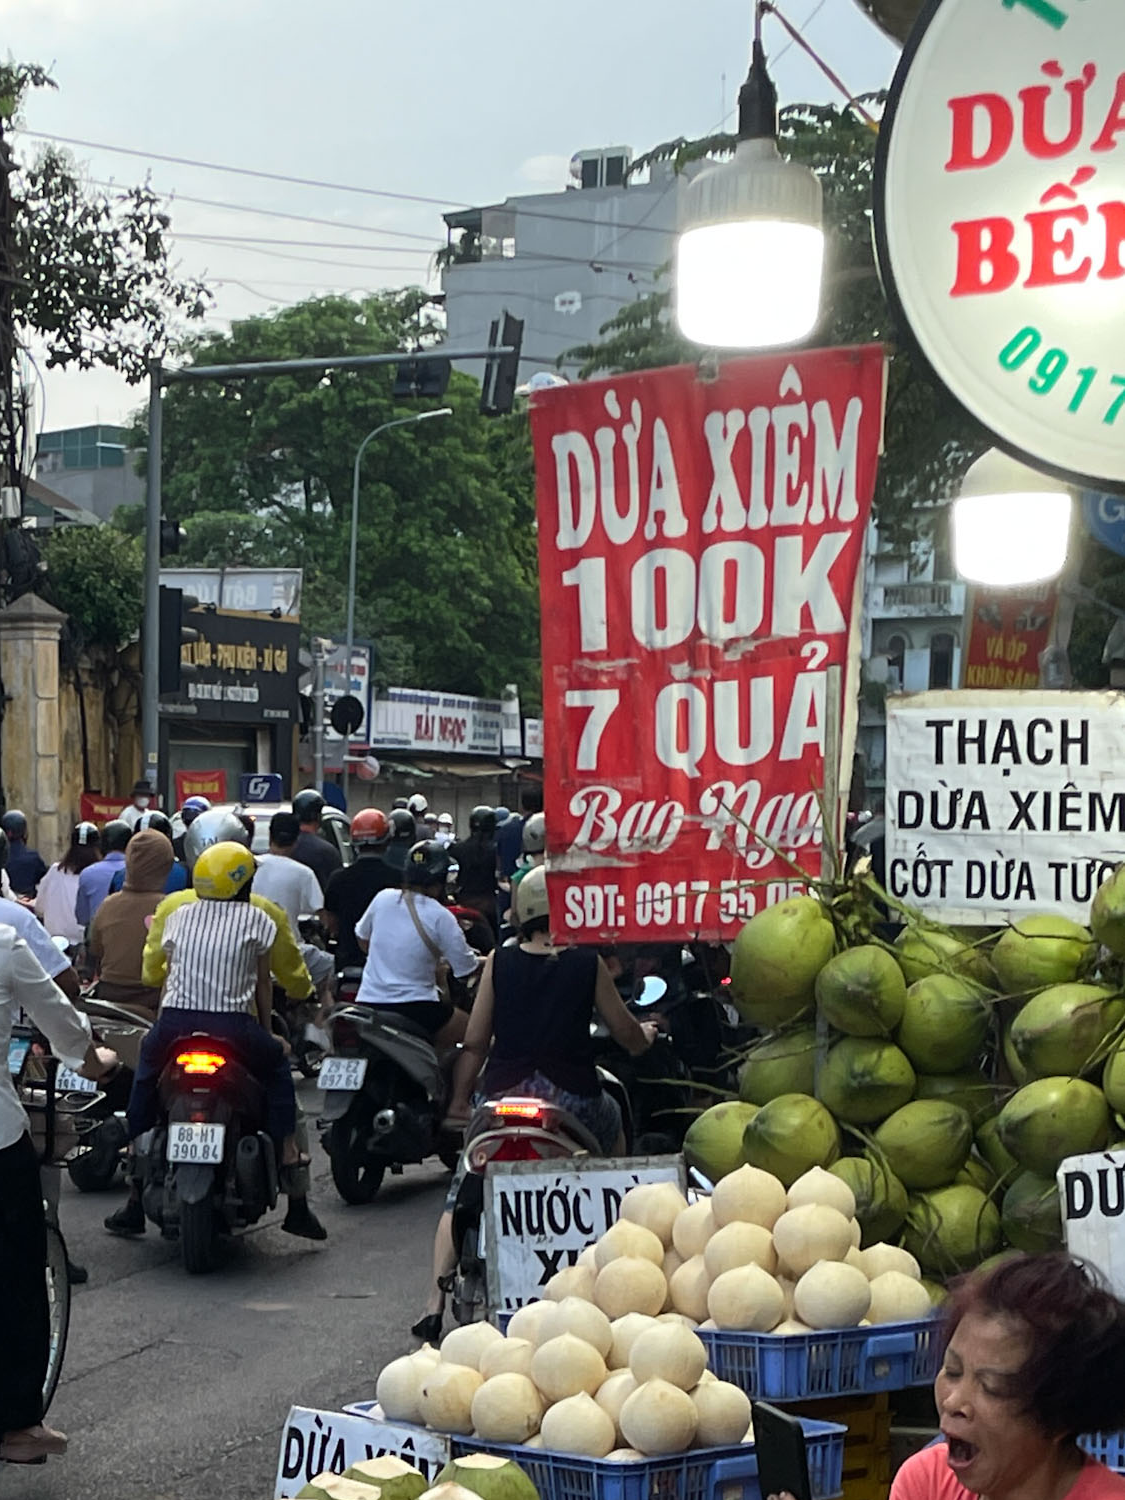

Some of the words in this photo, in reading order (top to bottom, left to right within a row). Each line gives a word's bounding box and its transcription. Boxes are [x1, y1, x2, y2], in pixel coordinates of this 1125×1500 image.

[551, 389, 689, 551] DỪA
[701, 363, 863, 534] XIÊM
[562, 529, 853, 653] 100K
[564, 688, 620, 771] 7
[654, 640, 829, 780] QUẢ
[925, 718, 1089, 777] THẠCH
[699, 780, 823, 869] Ngọ
[897, 780, 991, 831] DỪA
[1007, 782, 1125, 832] XIÊM
[889, 842, 954, 899] CỐT
[966, 850, 1036, 902] DỪA
[565, 884, 625, 929] SĐT:
[636, 881, 710, 926] 0917
[720, 879, 756, 924] 55
[172, 1144, 218, 1160] 390.84
[177, 1126, 215, 1143] 88-H1
[499, 1177, 595, 1237] NƯỚC
[282, 1414, 346, 1484] DỪA
